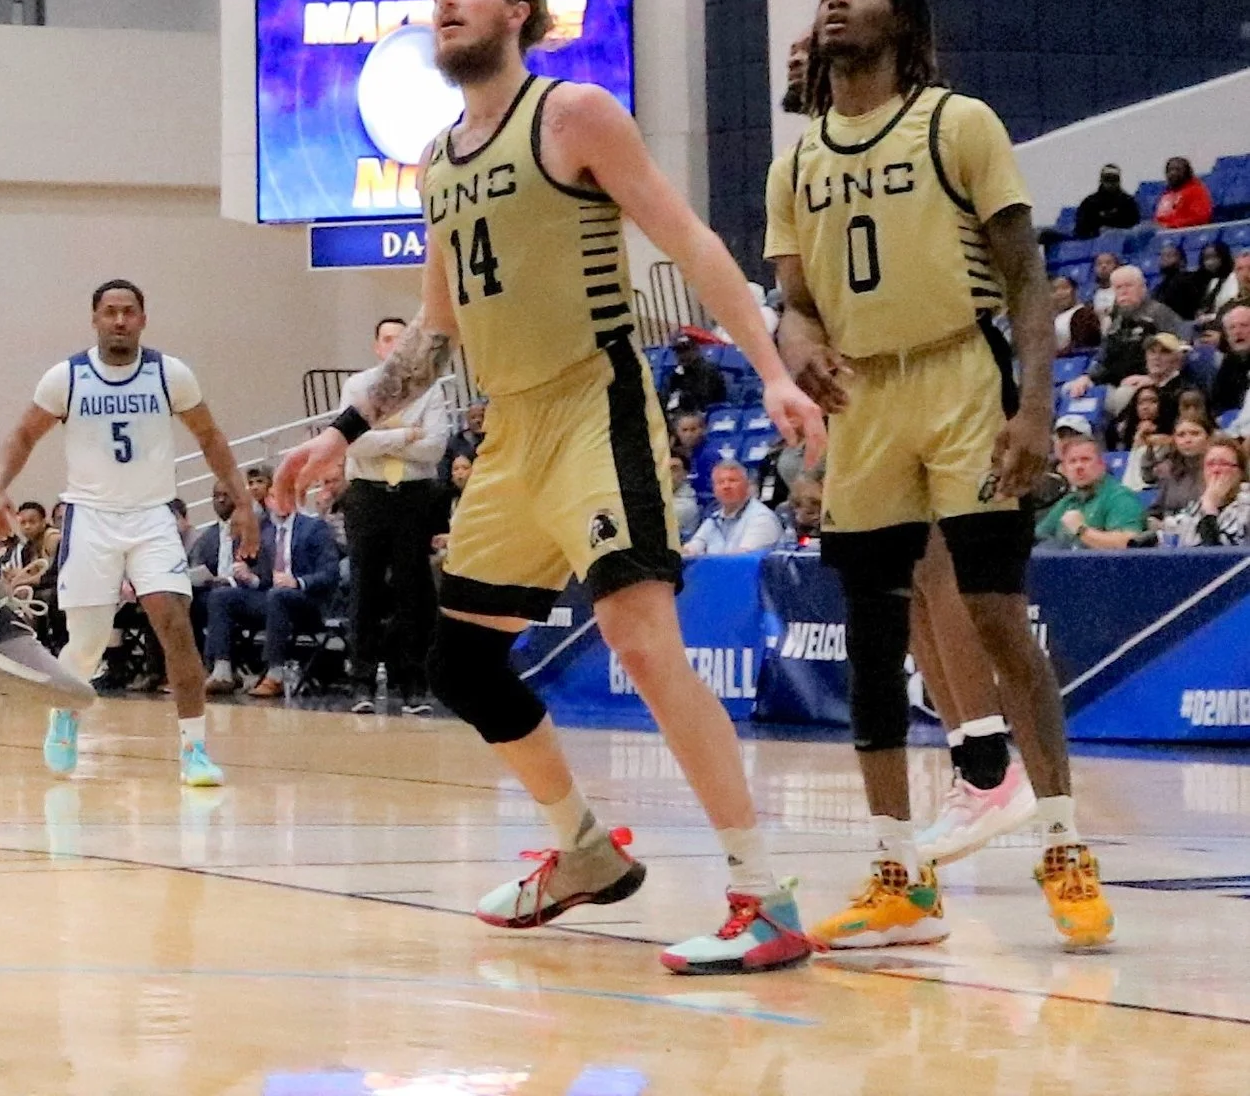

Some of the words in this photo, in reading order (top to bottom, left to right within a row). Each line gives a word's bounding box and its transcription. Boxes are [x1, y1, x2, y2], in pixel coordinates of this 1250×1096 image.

[430, 162, 517, 224] UNC
[805, 162, 915, 212] UNC
[450, 216, 504, 306] 14
[848, 215, 882, 294] 0
[80, 393, 161, 417] AUGUSTA
[111, 421, 133, 464] 5
[780, 621, 849, 661] WELCO
